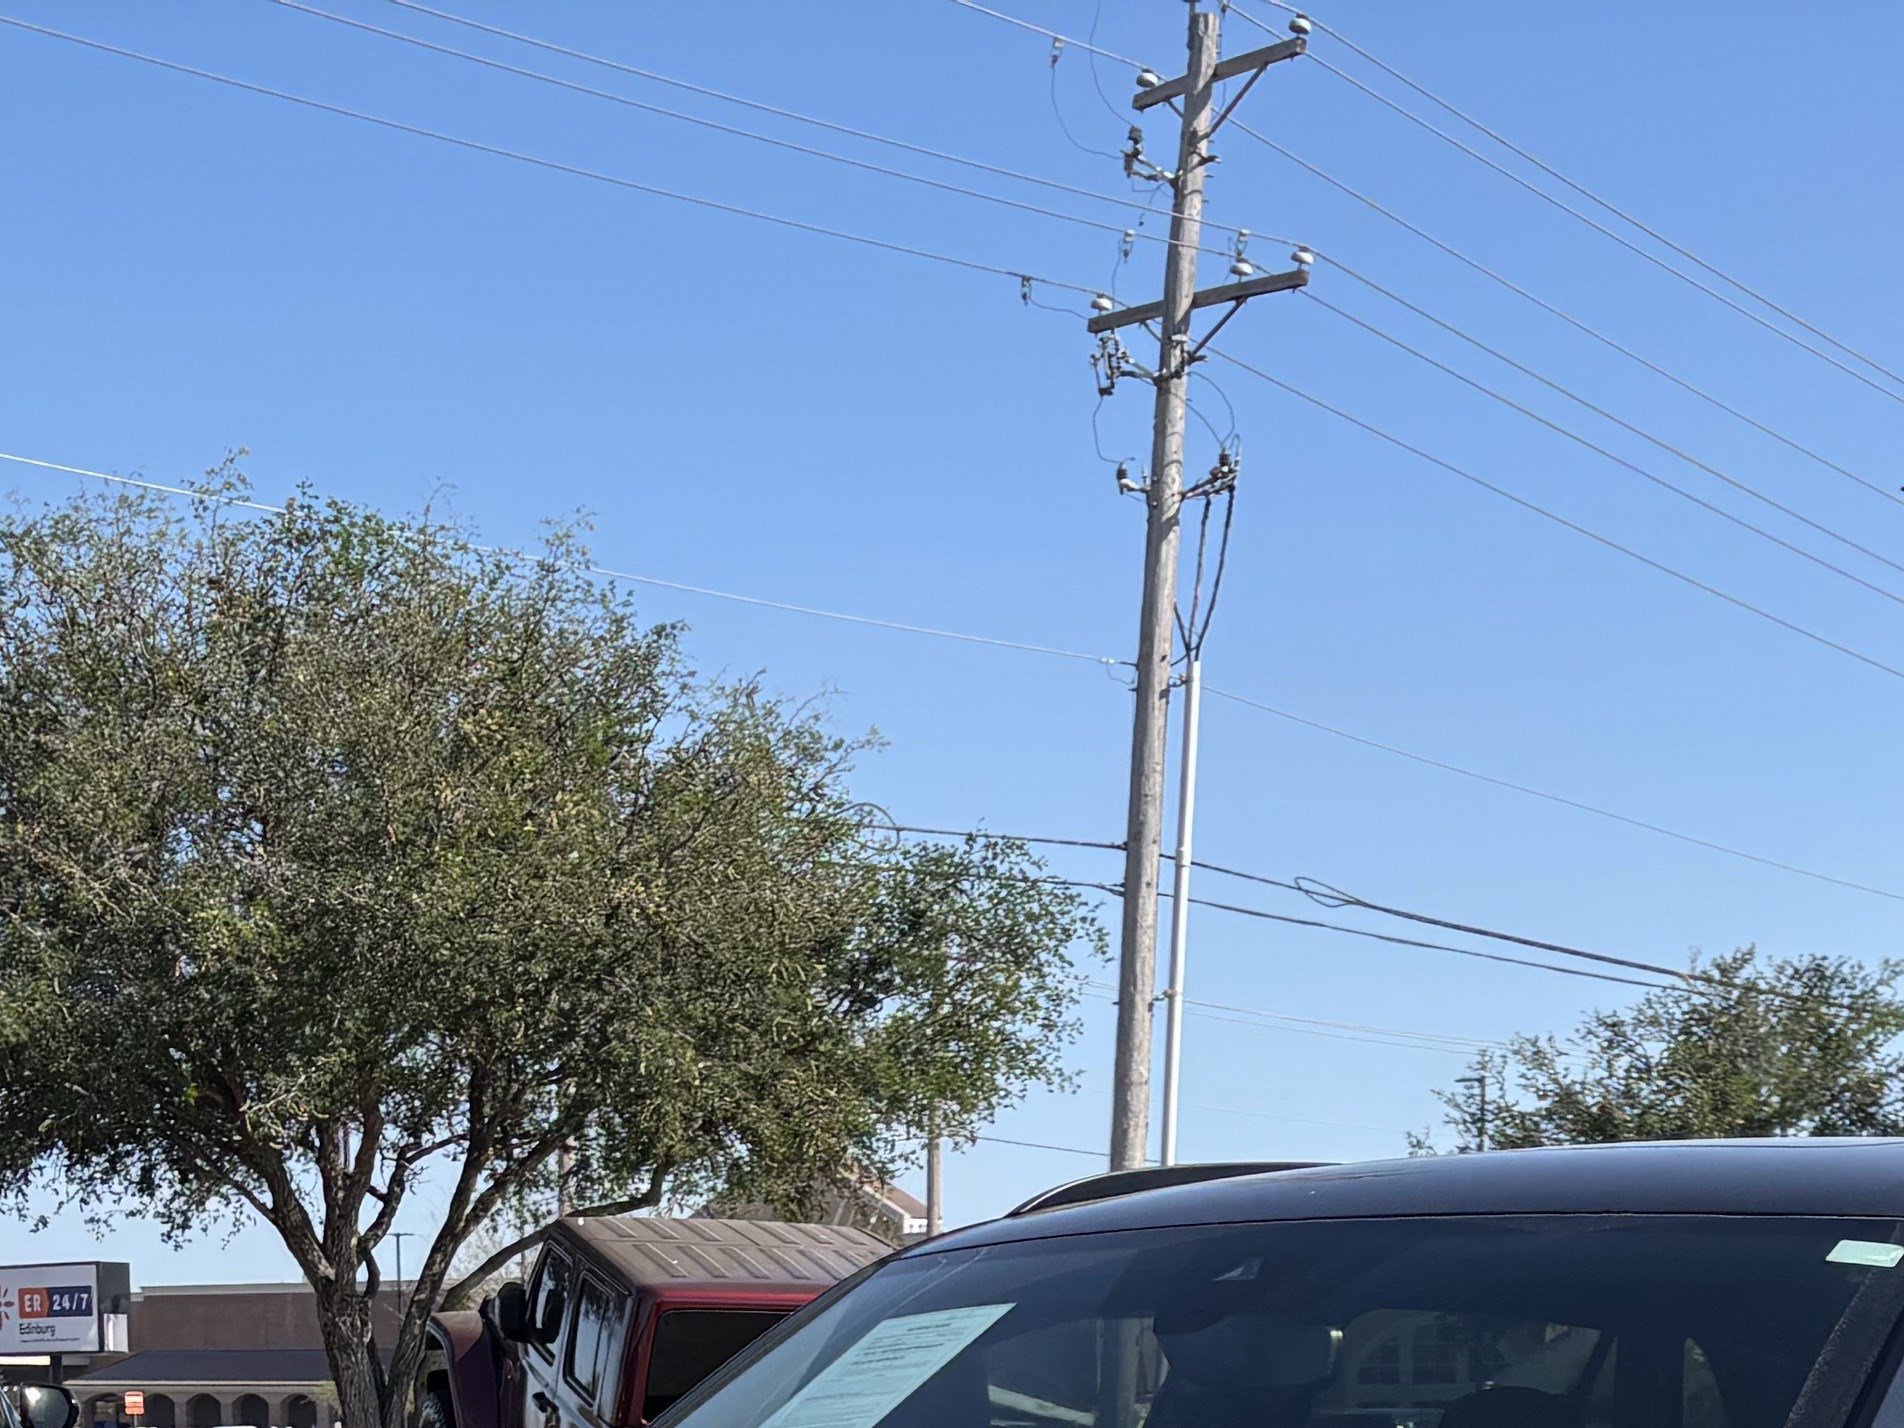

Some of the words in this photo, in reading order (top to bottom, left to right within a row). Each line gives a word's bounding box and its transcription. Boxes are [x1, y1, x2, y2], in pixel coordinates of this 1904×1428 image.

[23, 1294, 41, 1313] ER
[52, 1292, 89, 1312] 24/7
[19, 1323, 56, 1337] Edinburg
